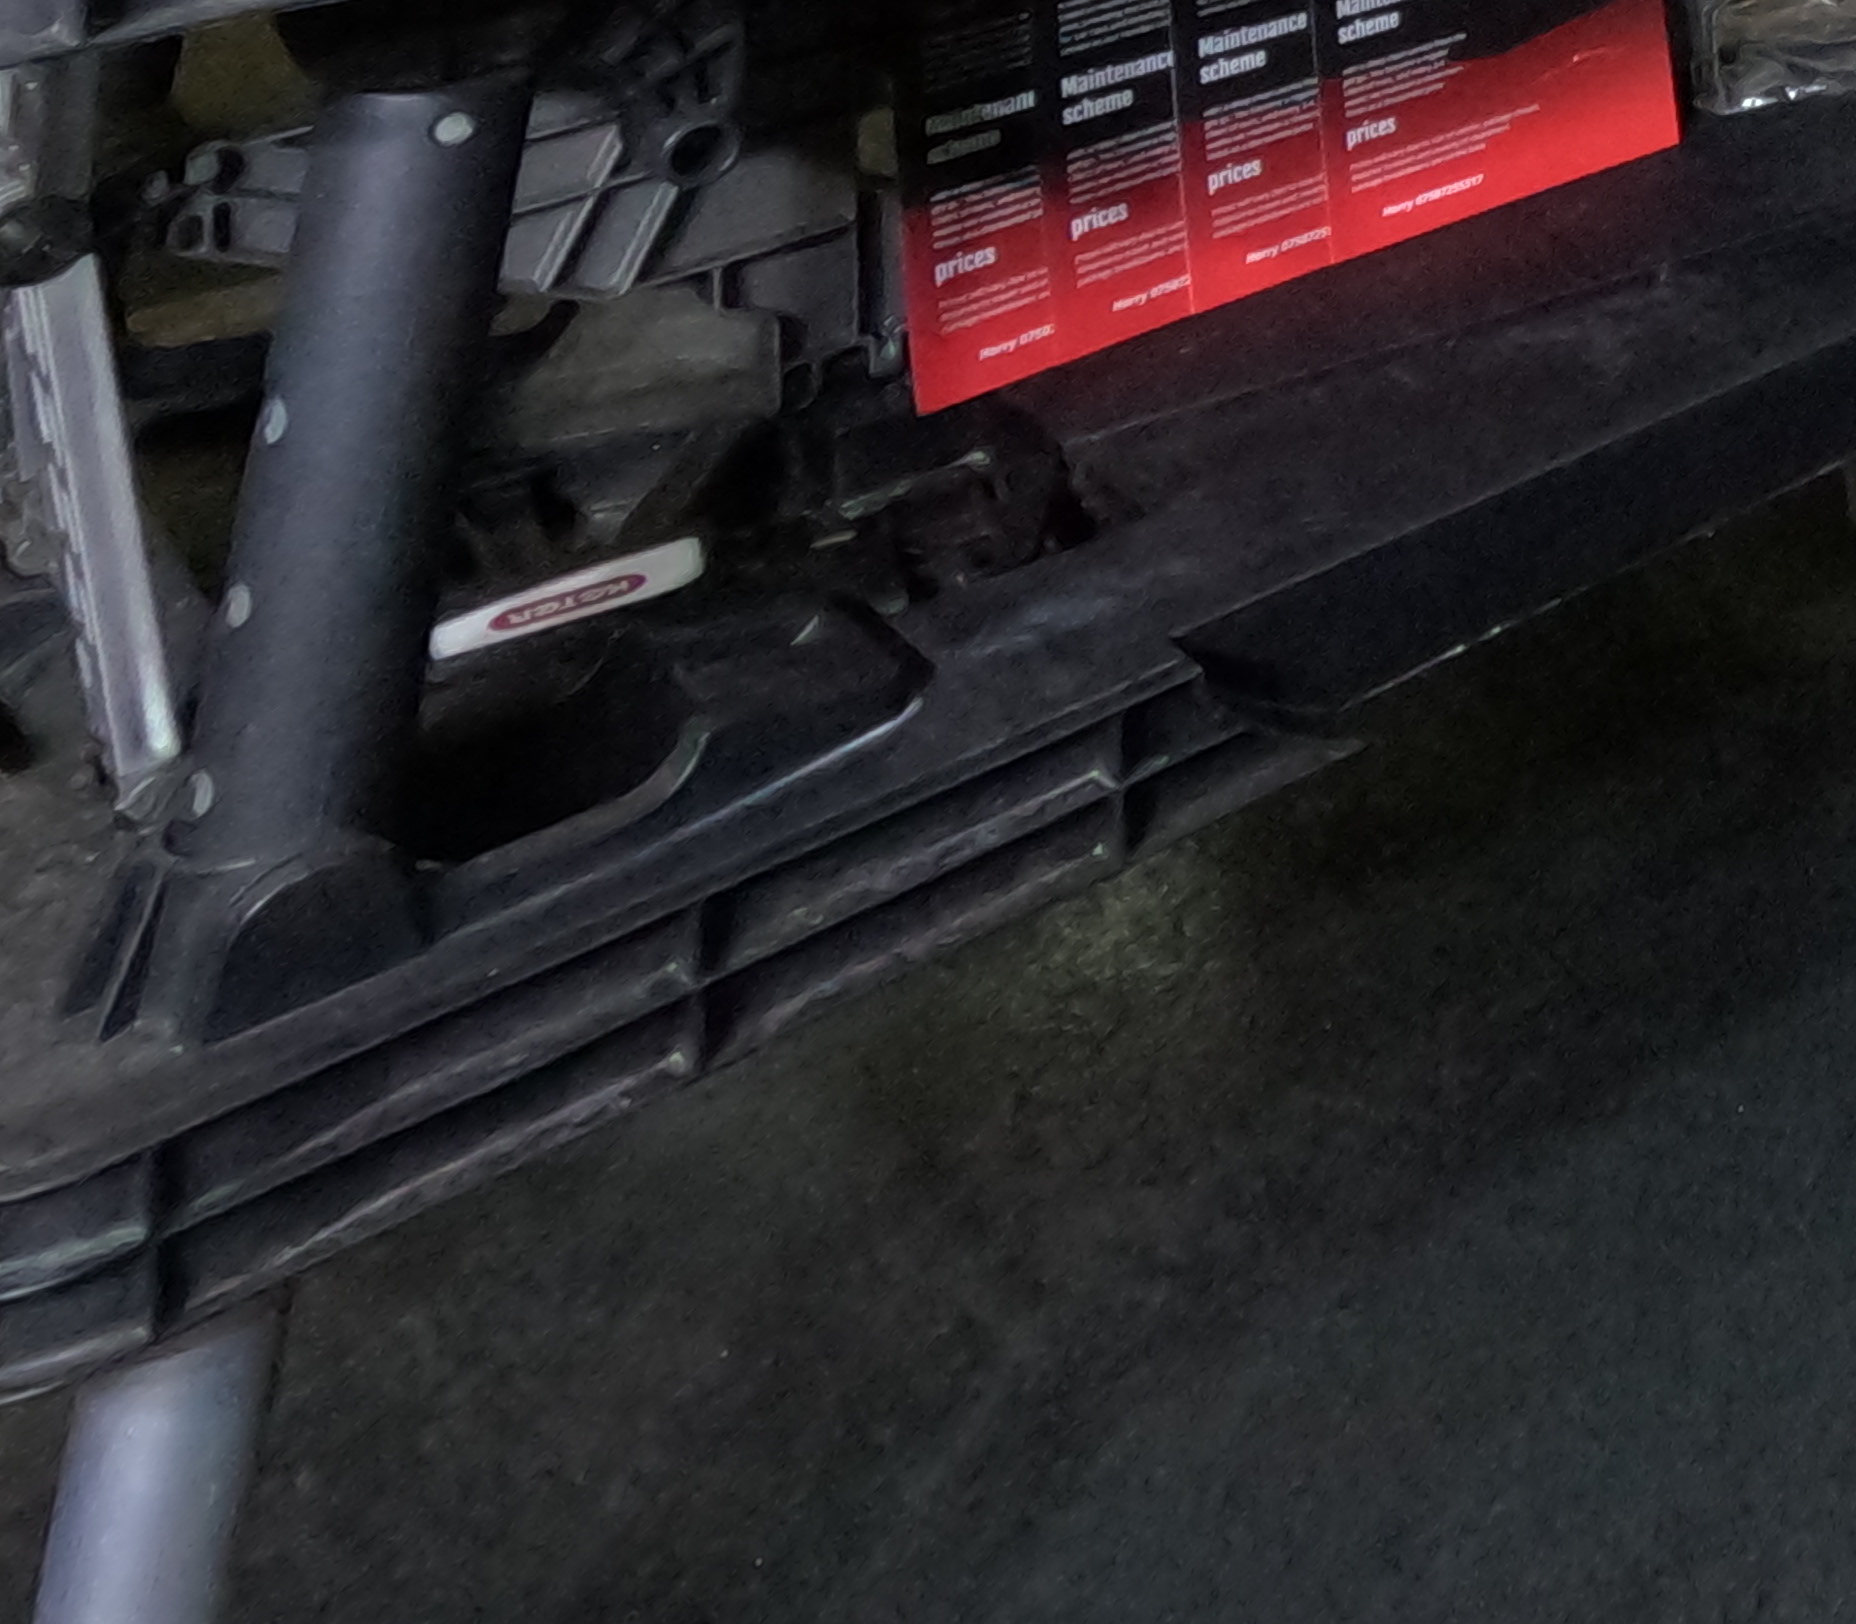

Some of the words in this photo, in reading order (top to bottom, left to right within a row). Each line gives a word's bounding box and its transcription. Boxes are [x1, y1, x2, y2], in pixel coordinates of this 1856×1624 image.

[1198, 11, 1308, 58] Maintenance
[1337, 9, 1401, 45] scheme
[1199, 49, 1267, 85] scheme
[1061, 88, 1134, 126] scheme
[1345, 115, 1397, 152] prices
[1206, 158, 1262, 196] prices
[1070, 202, 1129, 242] prices
[934, 246, 997, 288] prices
